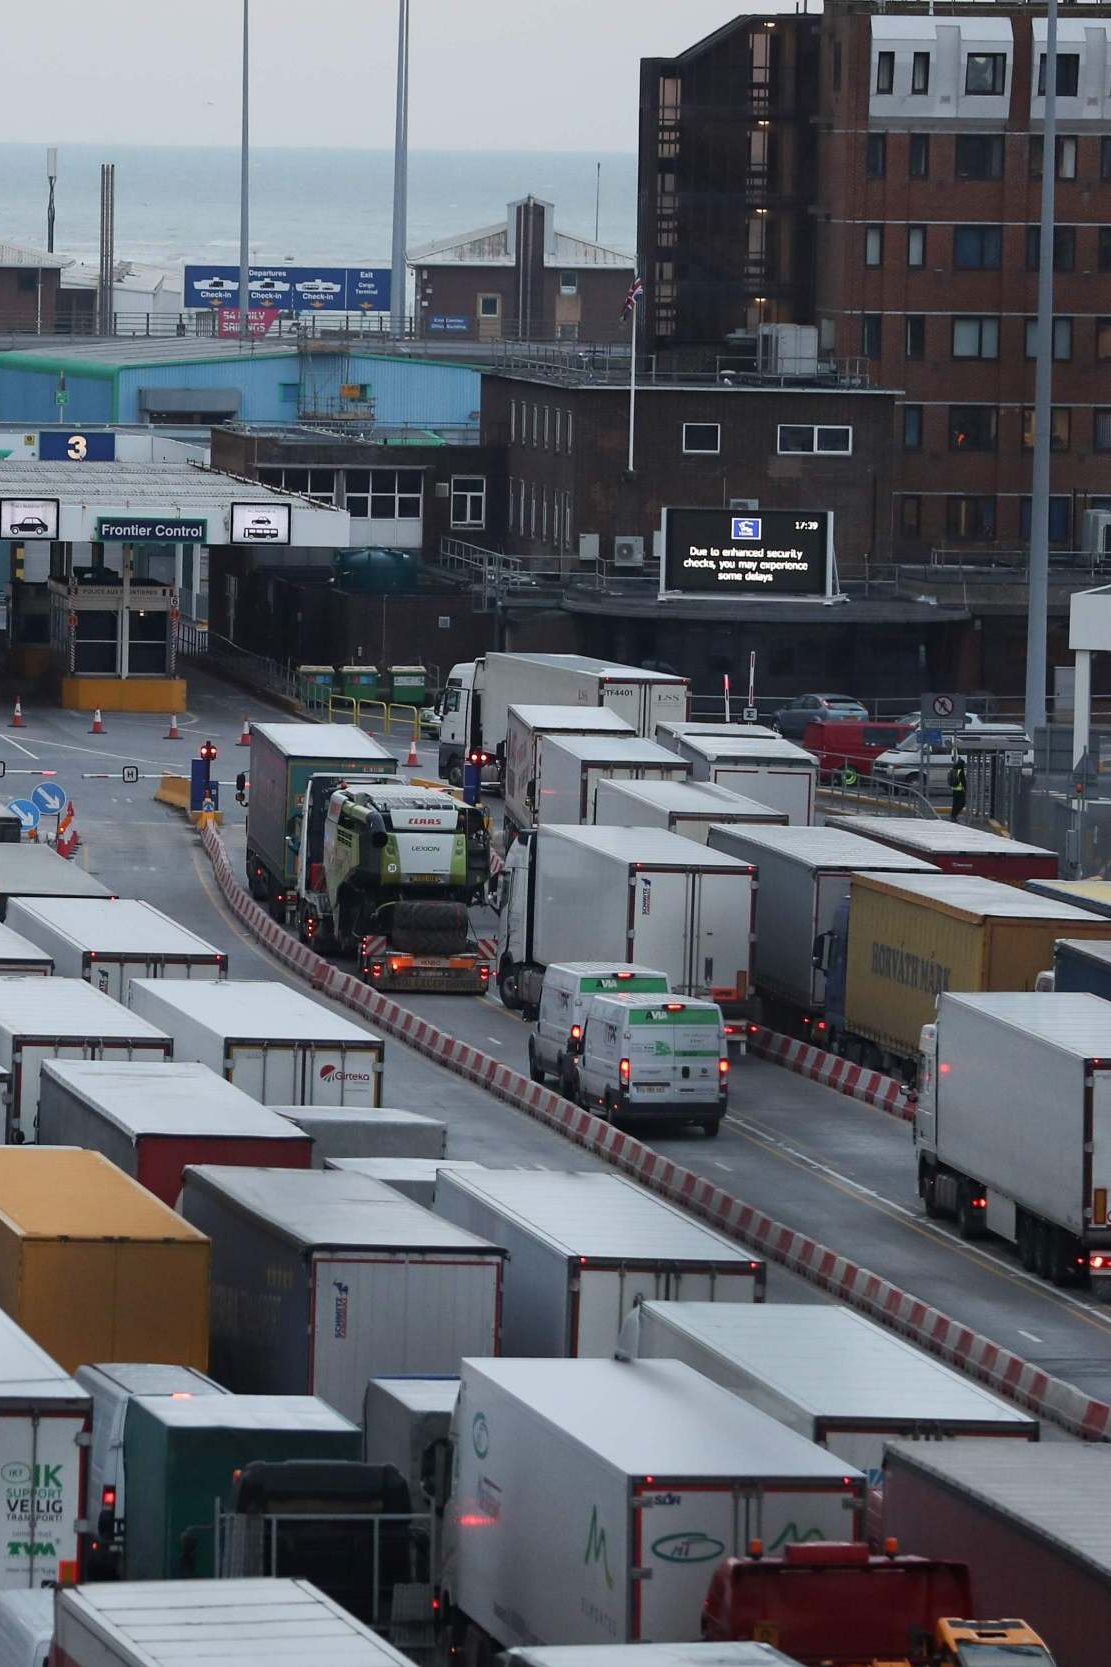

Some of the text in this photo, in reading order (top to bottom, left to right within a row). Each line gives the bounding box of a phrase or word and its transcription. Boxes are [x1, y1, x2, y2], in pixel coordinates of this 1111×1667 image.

[67, 435, 88, 461] 3
[102, 524, 202, 537] Frontier Control
[690, 547, 803, 559] Due to enhanced security
[684, 559, 808, 571] checks, you may experience
[745, 572, 773, 582] delays
[127, 771, 135, 779] H
[596, 979, 617, 988] AVIA
[646, 1011, 667, 1020] AVIA
[335, 1071, 370, 1081] Girteka
